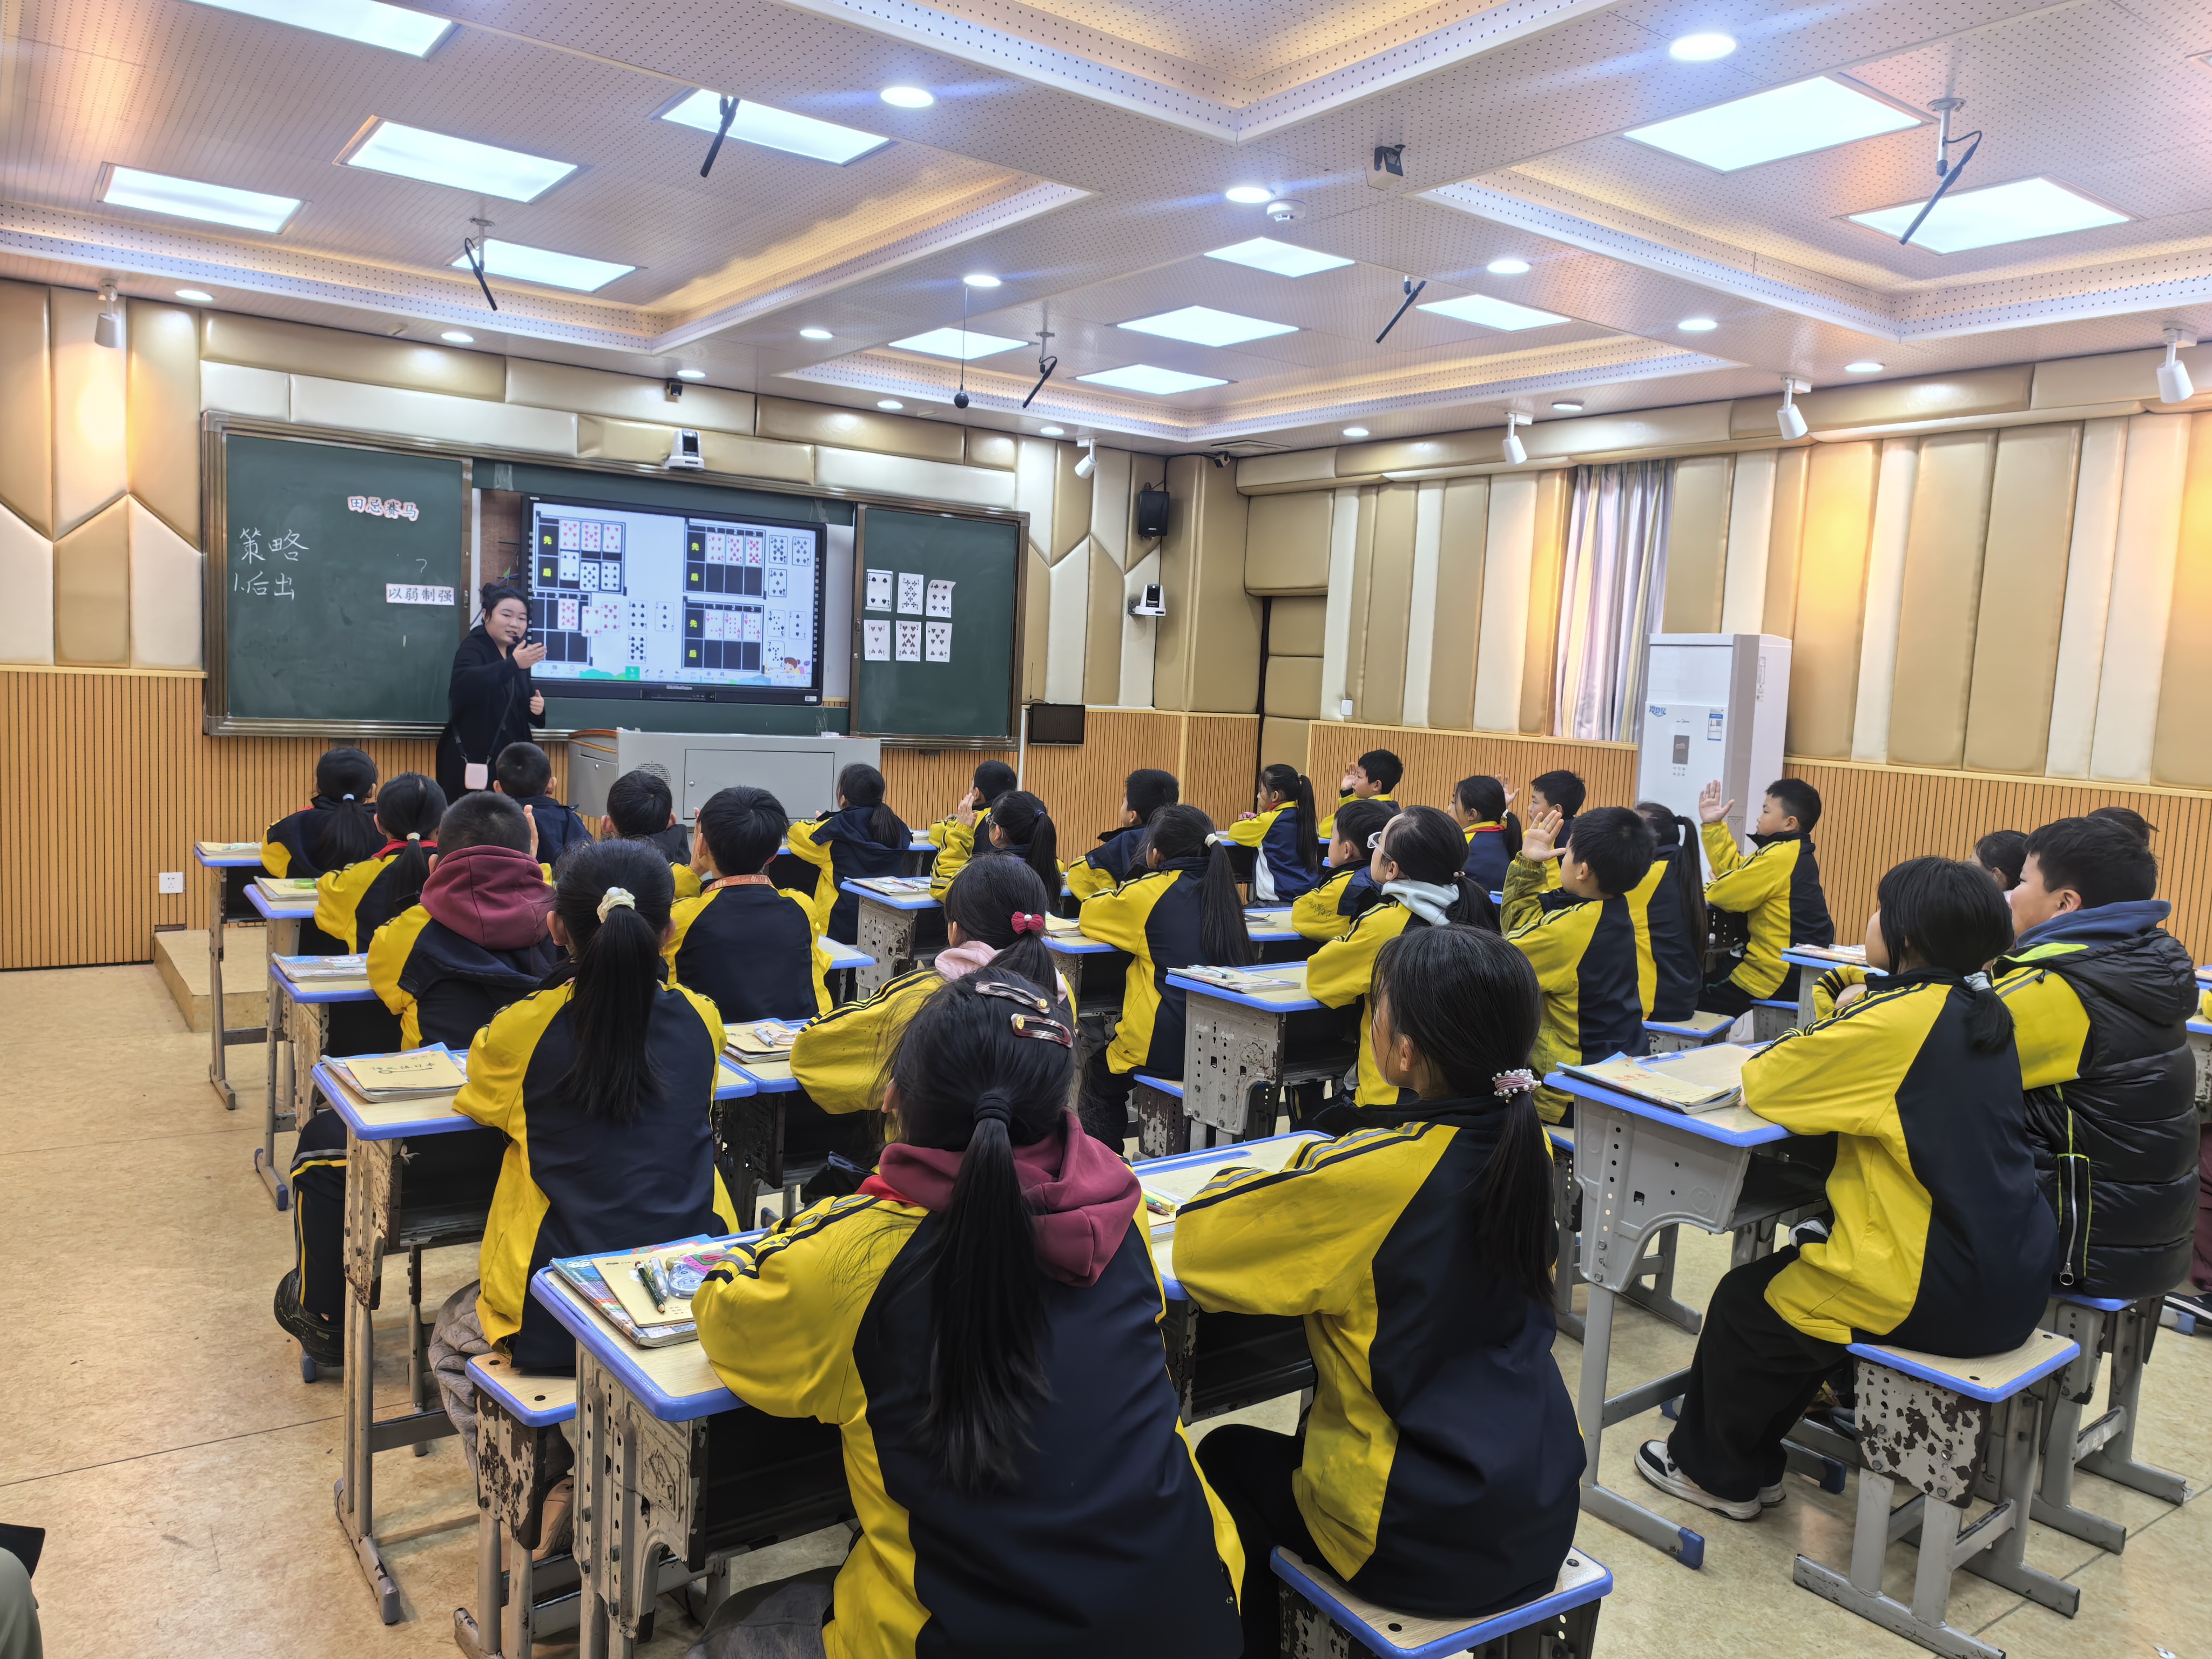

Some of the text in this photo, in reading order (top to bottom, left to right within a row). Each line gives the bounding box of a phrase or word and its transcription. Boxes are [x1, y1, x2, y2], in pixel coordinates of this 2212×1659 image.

[350, 498, 416, 519] 田忌赛马
[239, 527, 309, 564] 策略
[388, 587, 453, 603] 以弱制强
